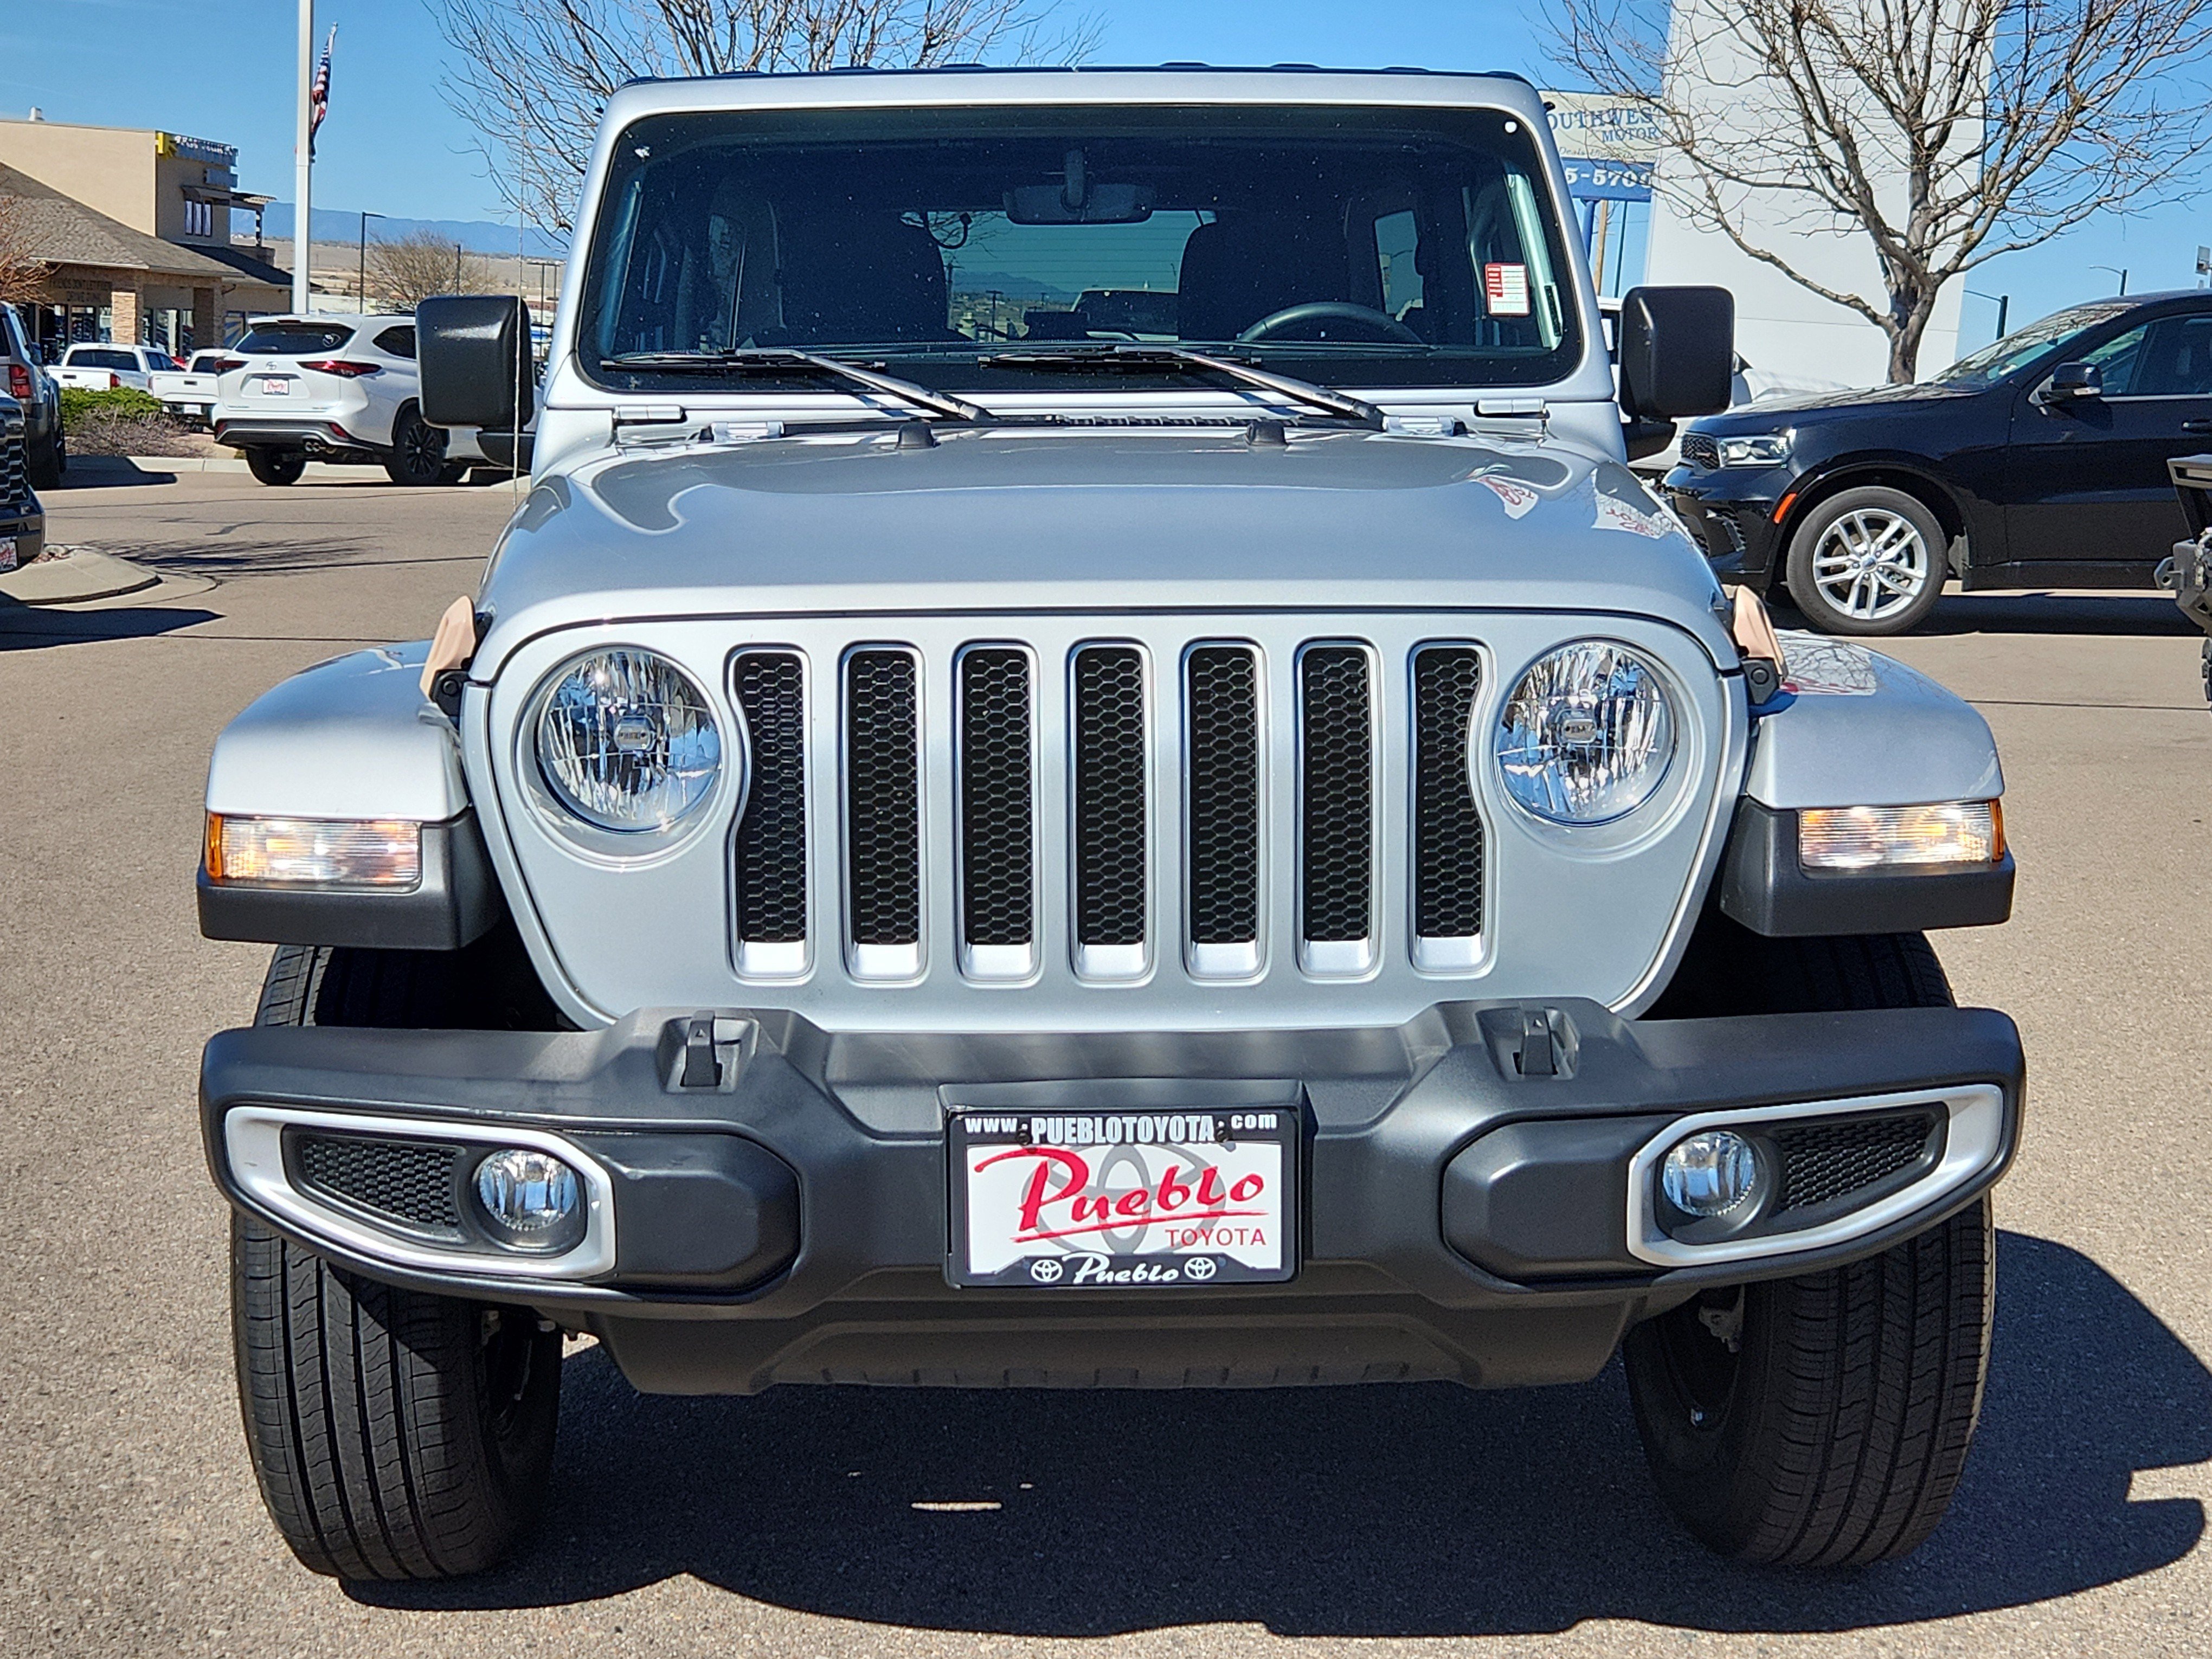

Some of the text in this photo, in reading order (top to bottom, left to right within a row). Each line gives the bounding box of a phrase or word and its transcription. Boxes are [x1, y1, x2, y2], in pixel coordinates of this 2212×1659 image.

[974, 1147, 1265, 1231] Pueblo
[1165, 1227, 1266, 1247] TOYOTA
[1062, 1251, 1179, 1285] Pueblo
